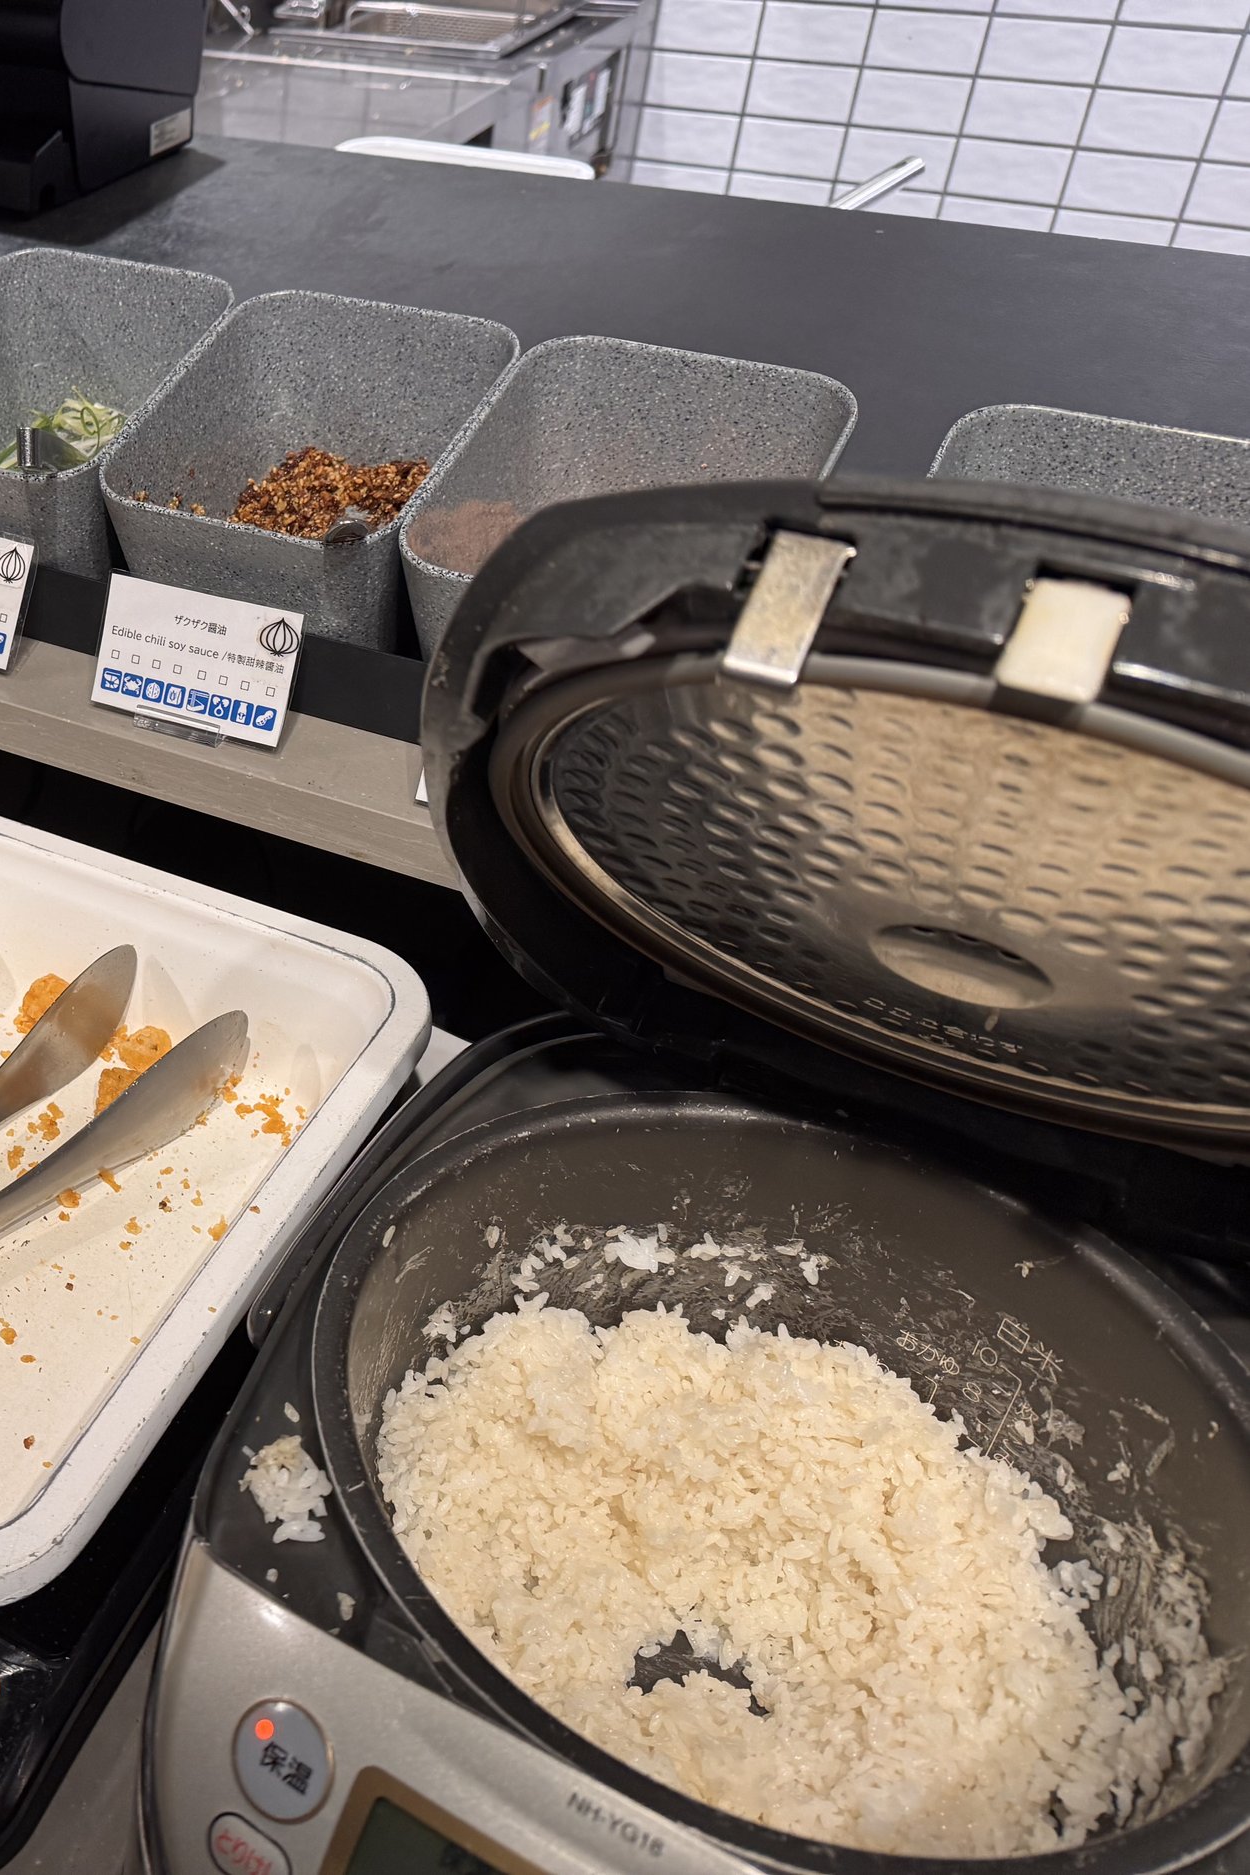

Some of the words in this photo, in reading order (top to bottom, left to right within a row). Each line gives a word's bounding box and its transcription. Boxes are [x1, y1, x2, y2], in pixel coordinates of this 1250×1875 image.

[111, 625, 142, 641] Edible
[145, 633, 166, 647] chili
[168, 639, 187, 652] soy
[188, 644, 219, 659] sauce
[174, 615, 227, 636] ザクザク醤油
[896, 1328, 960, 1376] おかゆ
[971, 1339, 999, 1367] 10
[997, 1318, 1064, 1373] 白米
[961, 1382, 982, 1403] 8
[260, 1741, 314, 1796] 保温
[566, 1792, 666, 1858] NH-YG18
